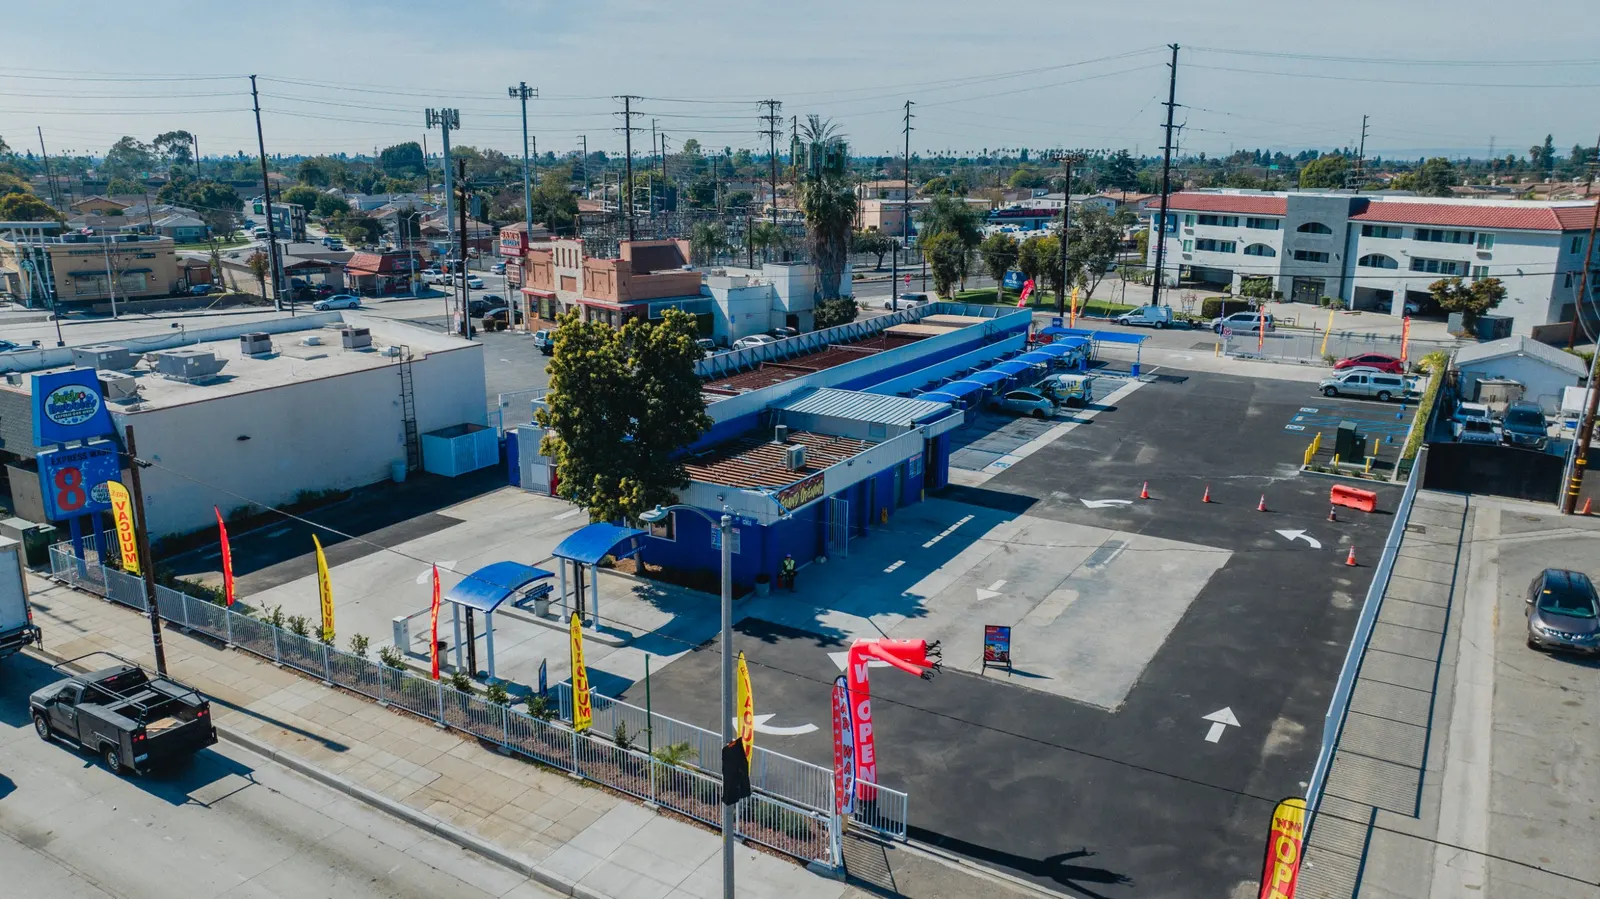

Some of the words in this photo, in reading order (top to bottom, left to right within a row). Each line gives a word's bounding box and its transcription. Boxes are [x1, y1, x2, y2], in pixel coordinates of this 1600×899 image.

[51, 453, 87, 465] EXPRESS
[55, 467, 86, 511] 8
[857, 700, 875, 784] OPEN
